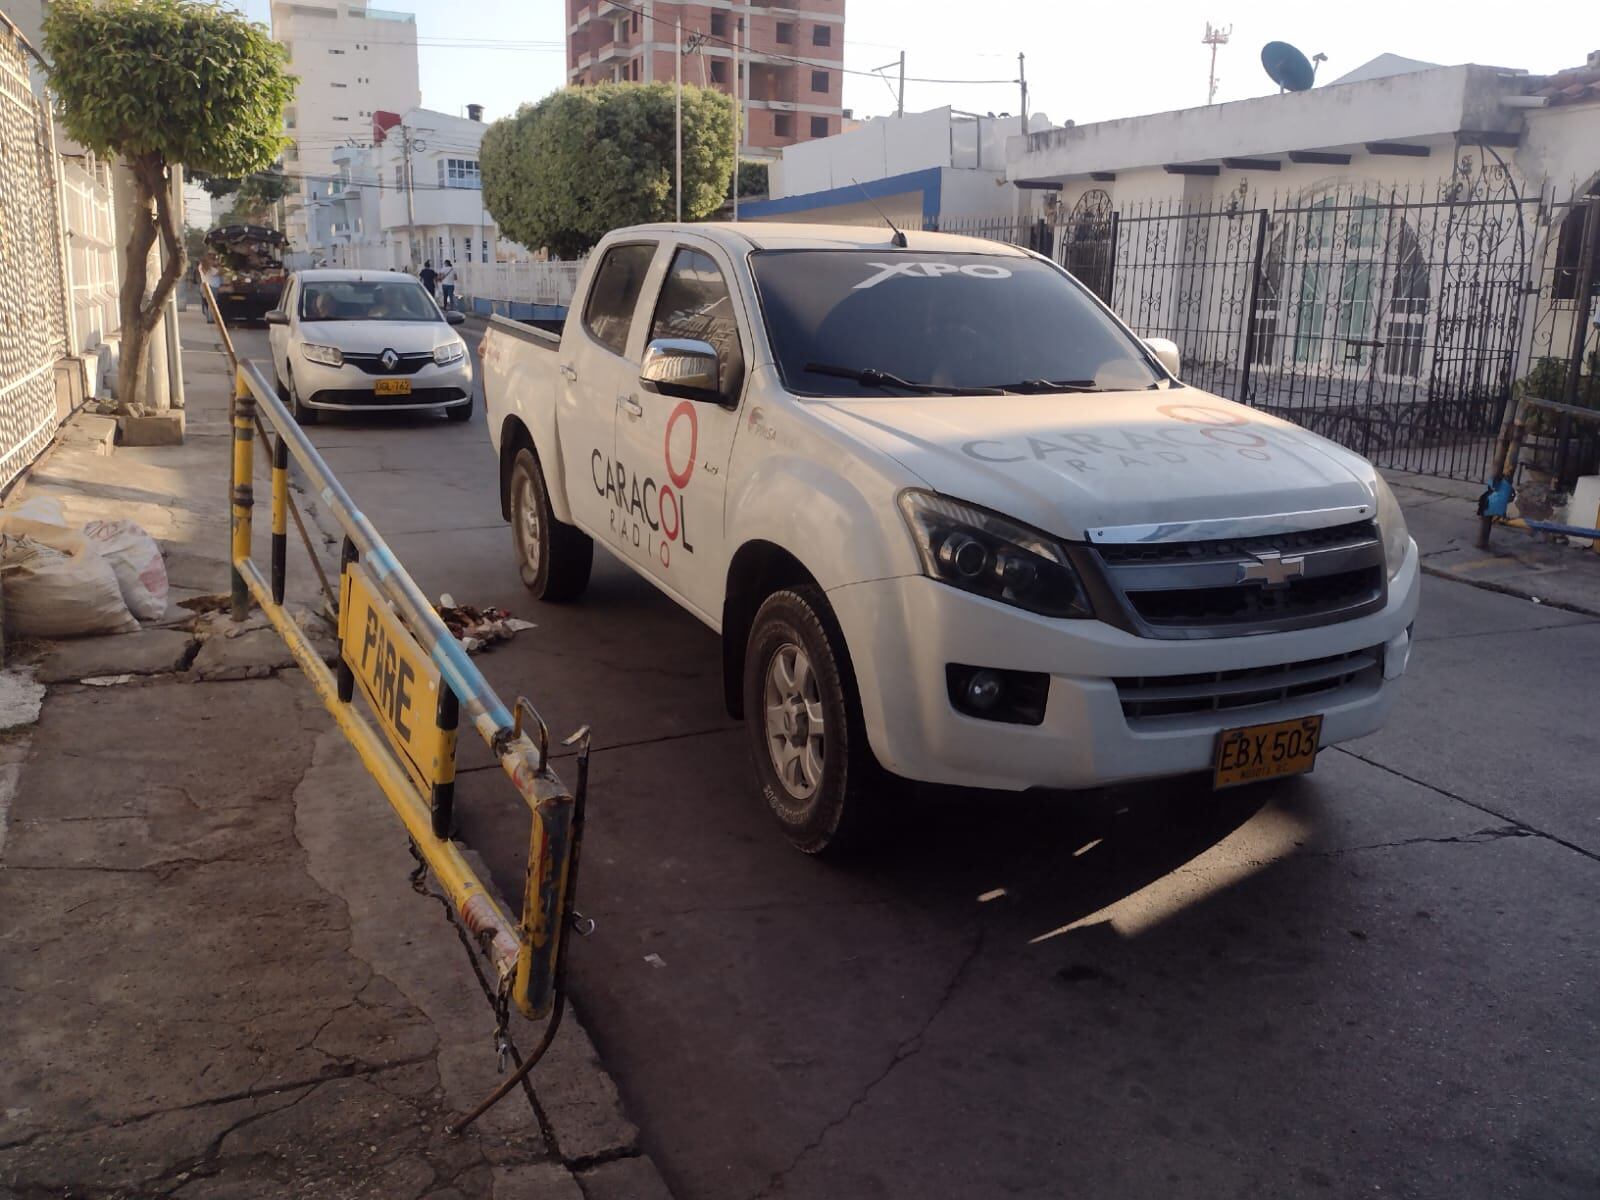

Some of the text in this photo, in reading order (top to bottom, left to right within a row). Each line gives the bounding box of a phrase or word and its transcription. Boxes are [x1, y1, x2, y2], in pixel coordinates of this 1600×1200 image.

[853, 262, 1013, 289] XPO
[961, 427, 1269, 464] CARACO
[1065, 448, 1271, 473] RADIO
[591, 448, 694, 554] CARACOL
[610, 508, 670, 568] RADIO
[361, 603, 415, 744] PARE
[1220, 725, 1317, 772] EBX 503
